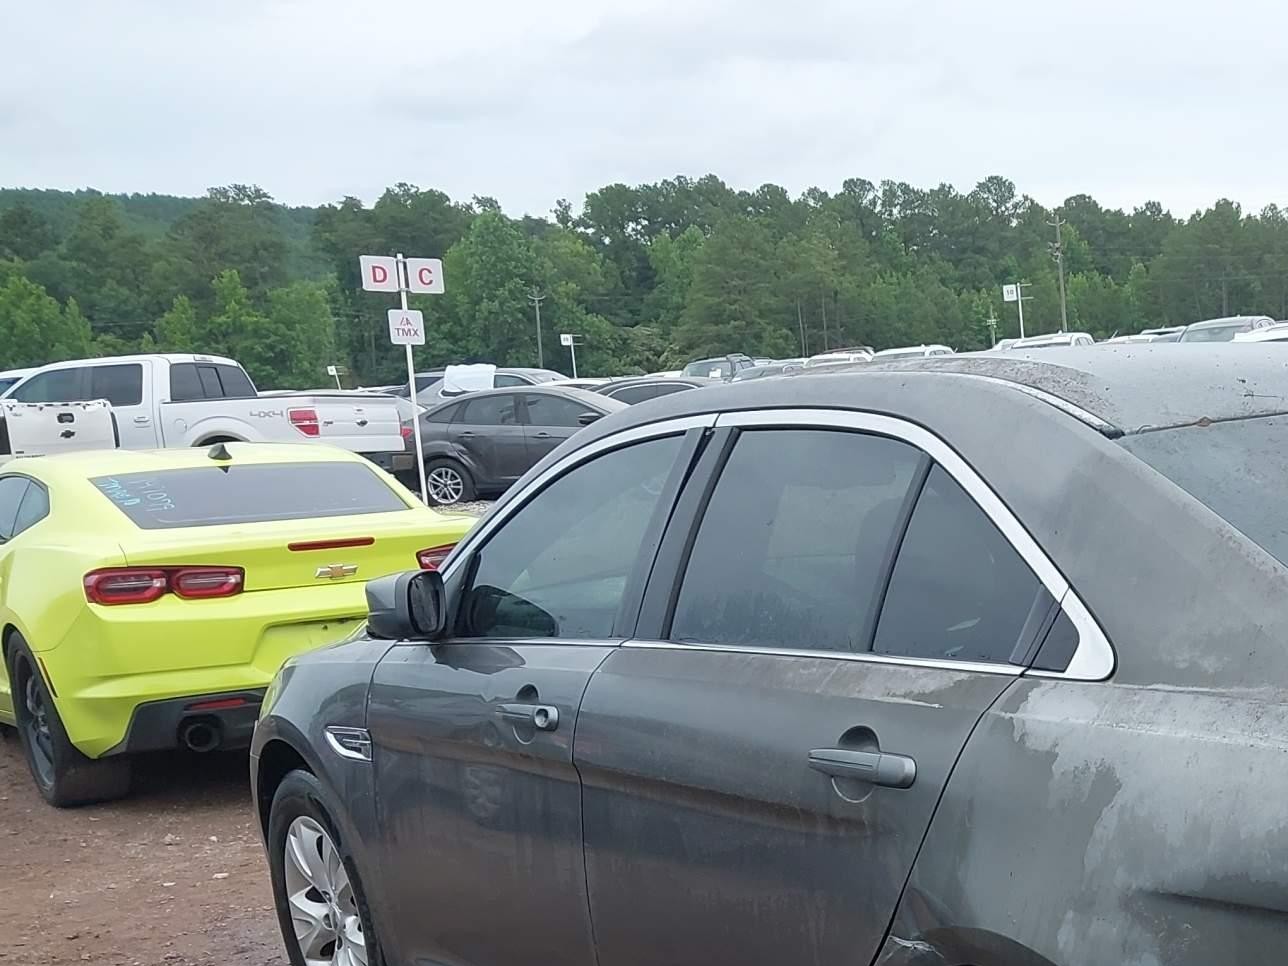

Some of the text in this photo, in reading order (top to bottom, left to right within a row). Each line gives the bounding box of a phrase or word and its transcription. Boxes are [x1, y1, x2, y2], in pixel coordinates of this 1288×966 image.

[371, 265, 388, 283] D
[418, 267, 434, 286] C
[394, 327, 420, 337] TMX
